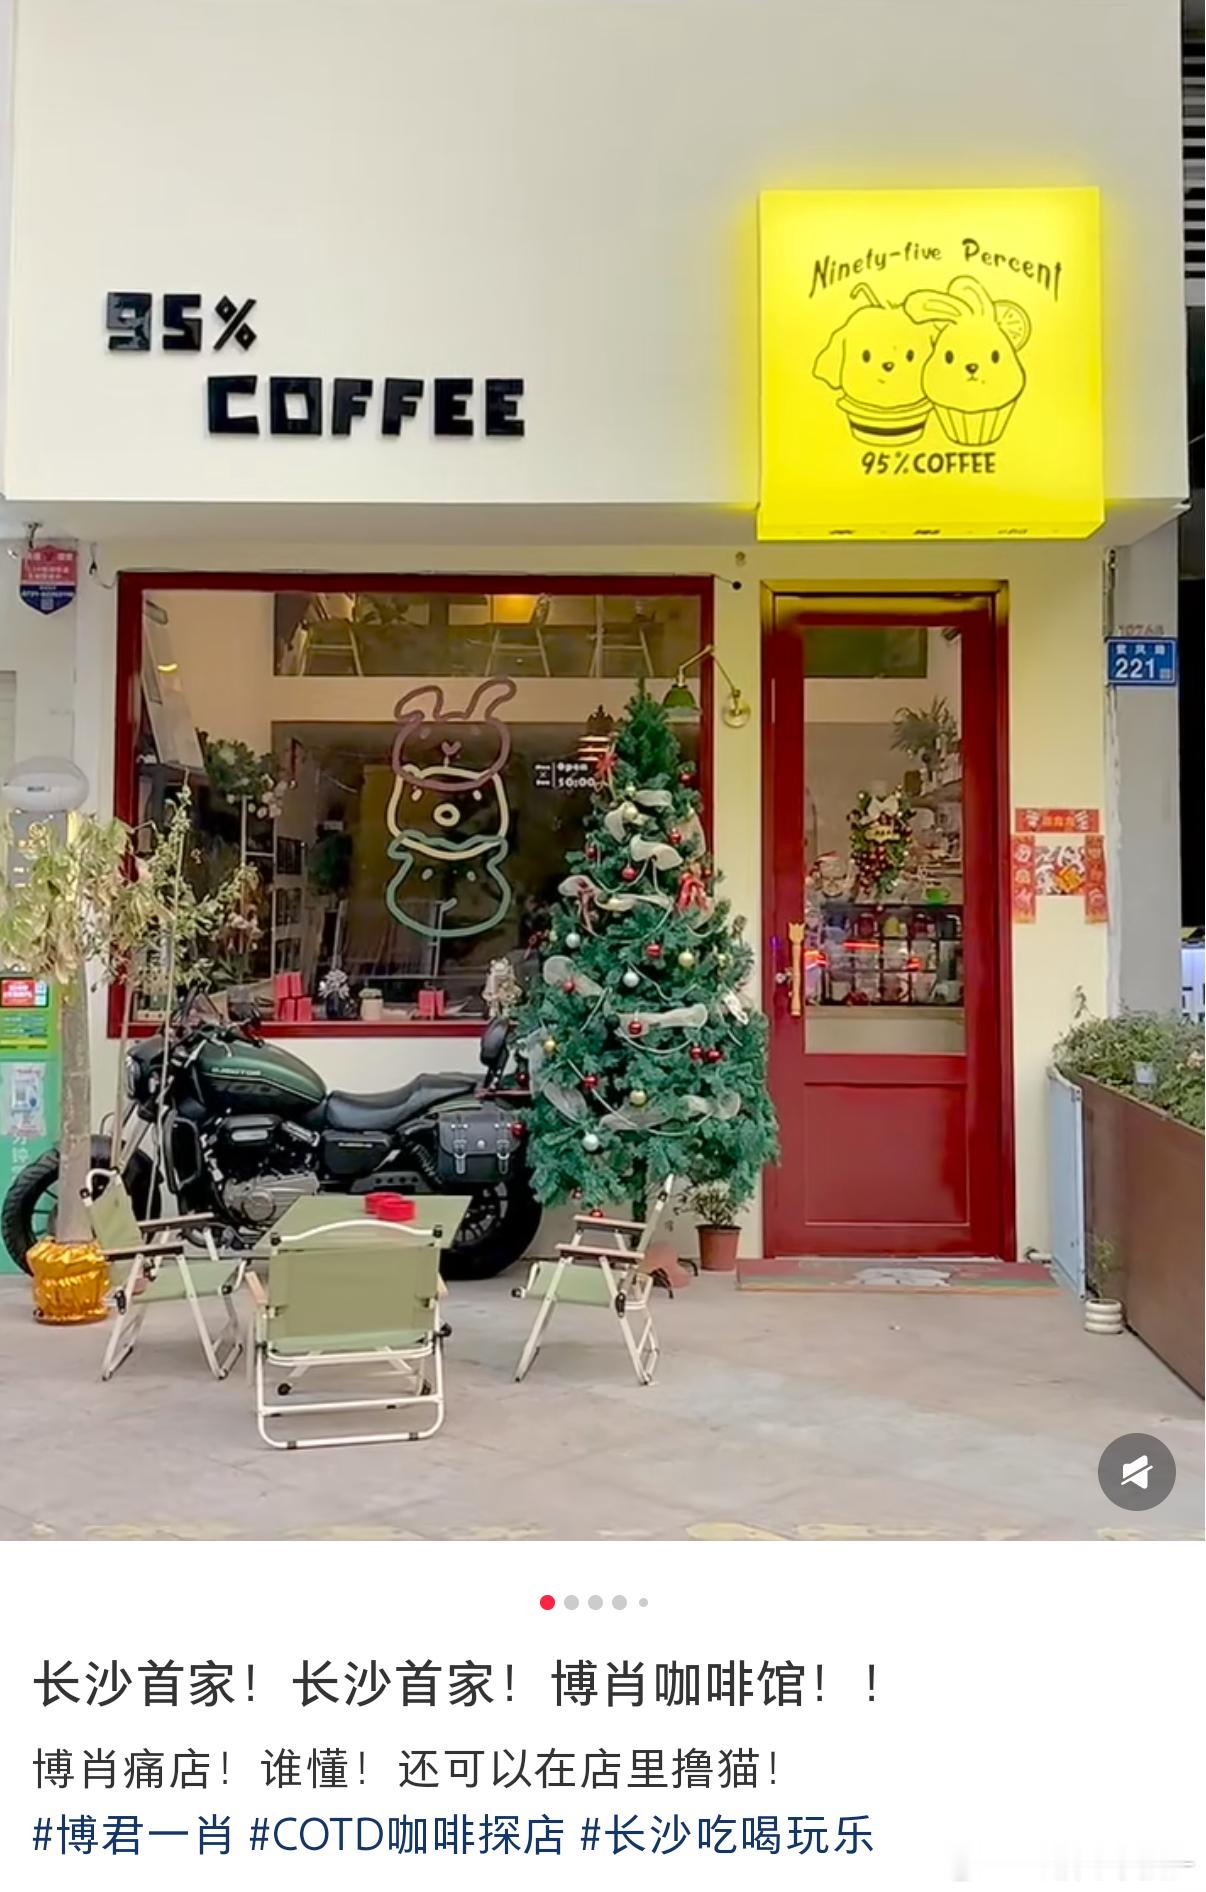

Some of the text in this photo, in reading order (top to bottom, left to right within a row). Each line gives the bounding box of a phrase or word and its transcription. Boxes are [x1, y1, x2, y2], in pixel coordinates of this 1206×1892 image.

[809, 238, 1062, 302] Ninety-five Percent
[106, 292, 257, 351] 95%
[207, 375, 525, 437] COFFEE
[1115, 657, 1155, 679] 221
[557, 762, 588, 772] Open
